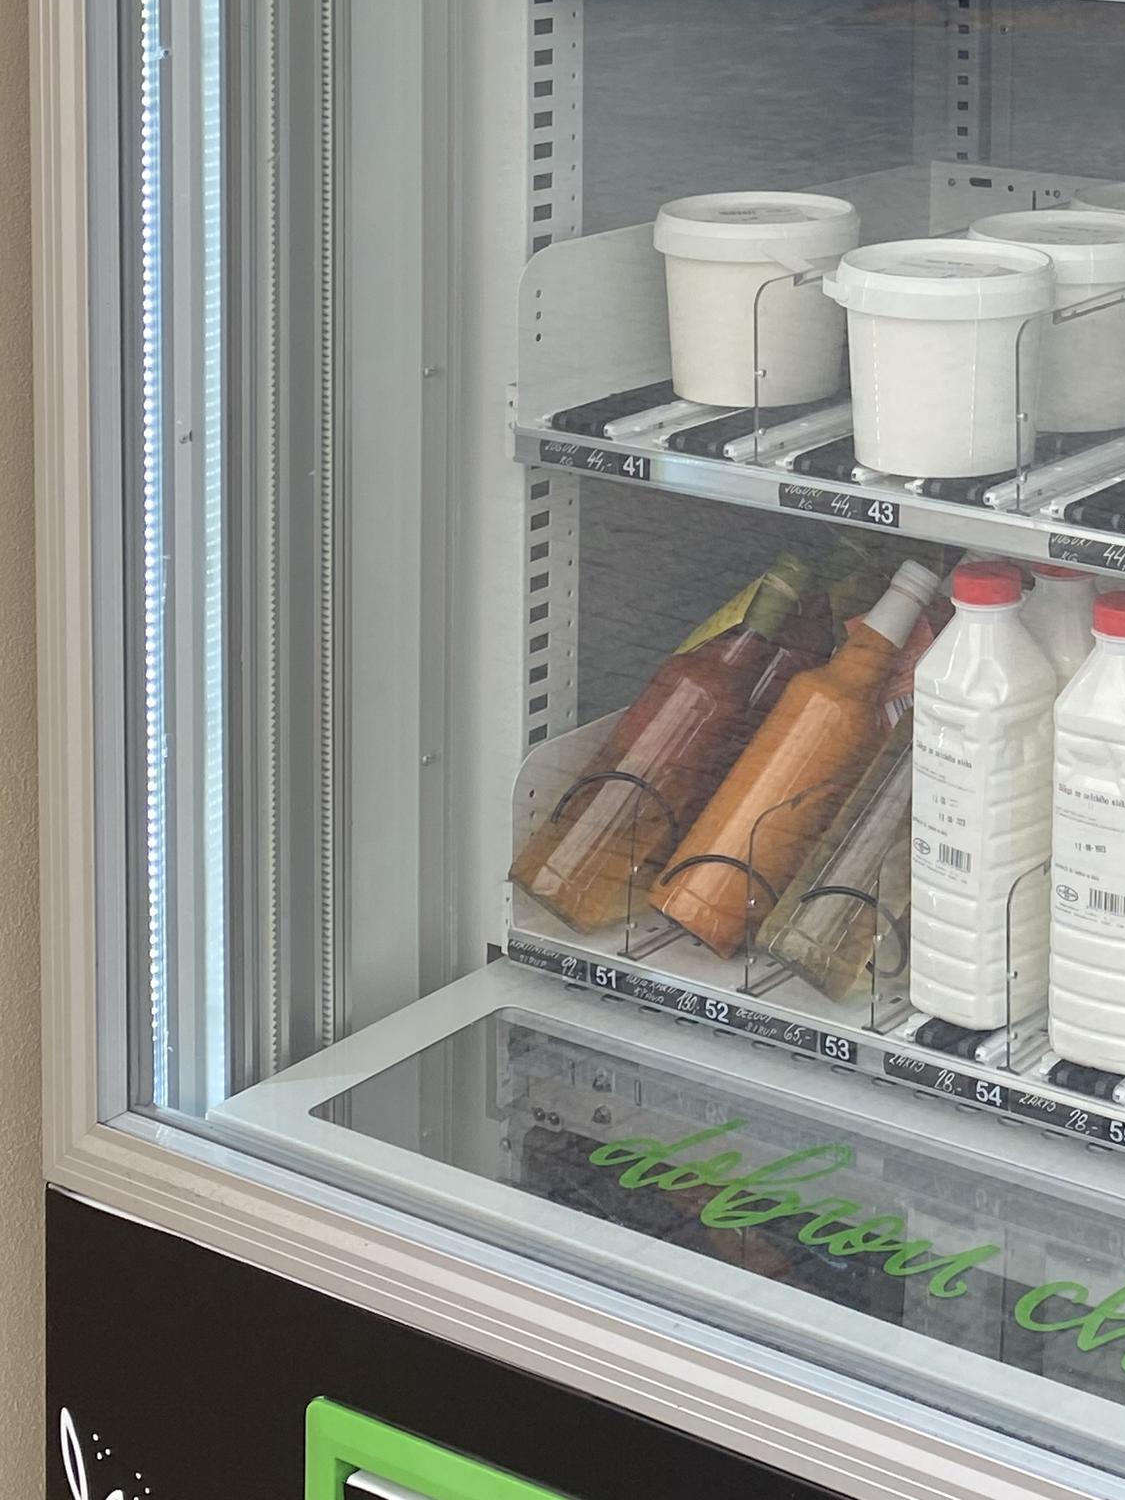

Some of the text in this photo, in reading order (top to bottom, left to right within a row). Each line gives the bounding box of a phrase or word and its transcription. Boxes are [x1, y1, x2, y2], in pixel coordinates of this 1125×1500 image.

[622, 456, 645, 478] 41
[867, 500, 894, 524] 43
[595, 965, 617, 989] 51
[705, 999, 729, 1023] 52
[824, 1035, 850, 1061] 53
[976, 1081, 1003, 1107] 54
[589, 1117, 1002, 1299] dobrou
